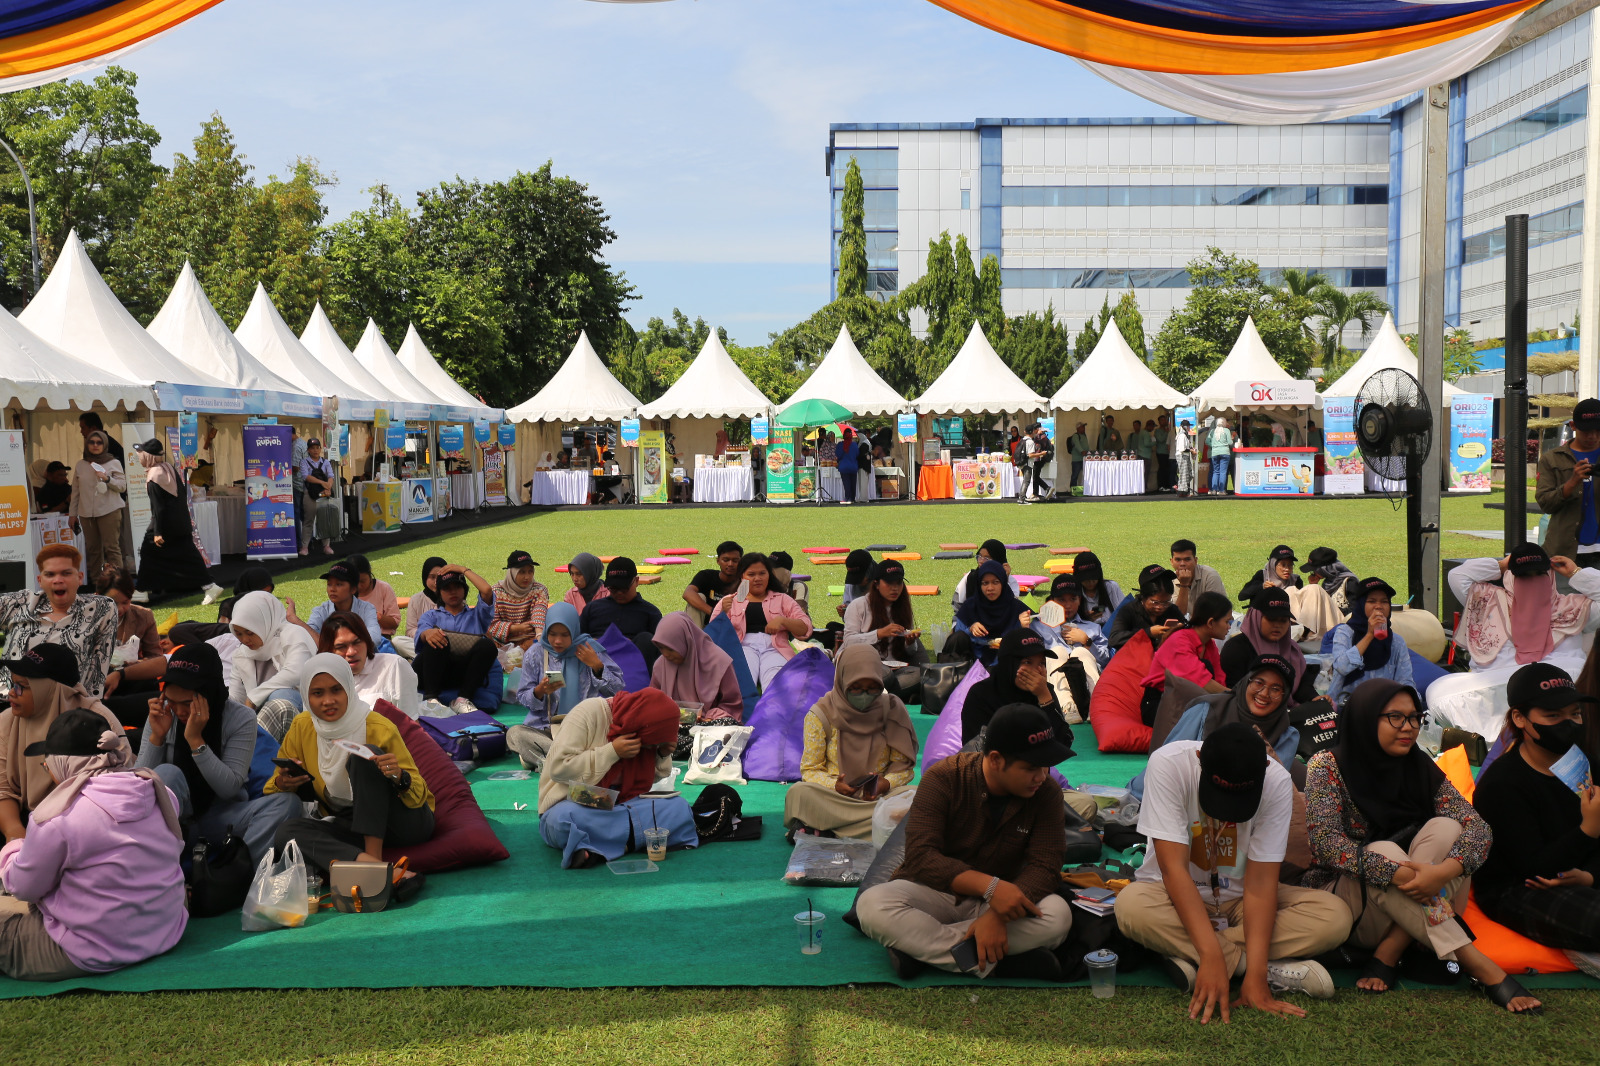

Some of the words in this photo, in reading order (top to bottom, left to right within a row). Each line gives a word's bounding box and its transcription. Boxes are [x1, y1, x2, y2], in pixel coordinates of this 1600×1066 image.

[1251, 388, 1273, 401] OJK
[214, 399, 223, 407] Bank
[1454, 403, 1488, 411] ORI023
[1326, 406, 1354, 414] ORI02
[1264, 457, 1289, 467] LMS
[6, 511, 22, 519] bank
[7, 520, 24, 529] LPS?
[1516, 555, 1542, 564] ORI023
[168, 660, 200, 673] ORI023
[1261, 657, 1291, 675] ORI023
[1312, 730, 1334, 744] KEEP
